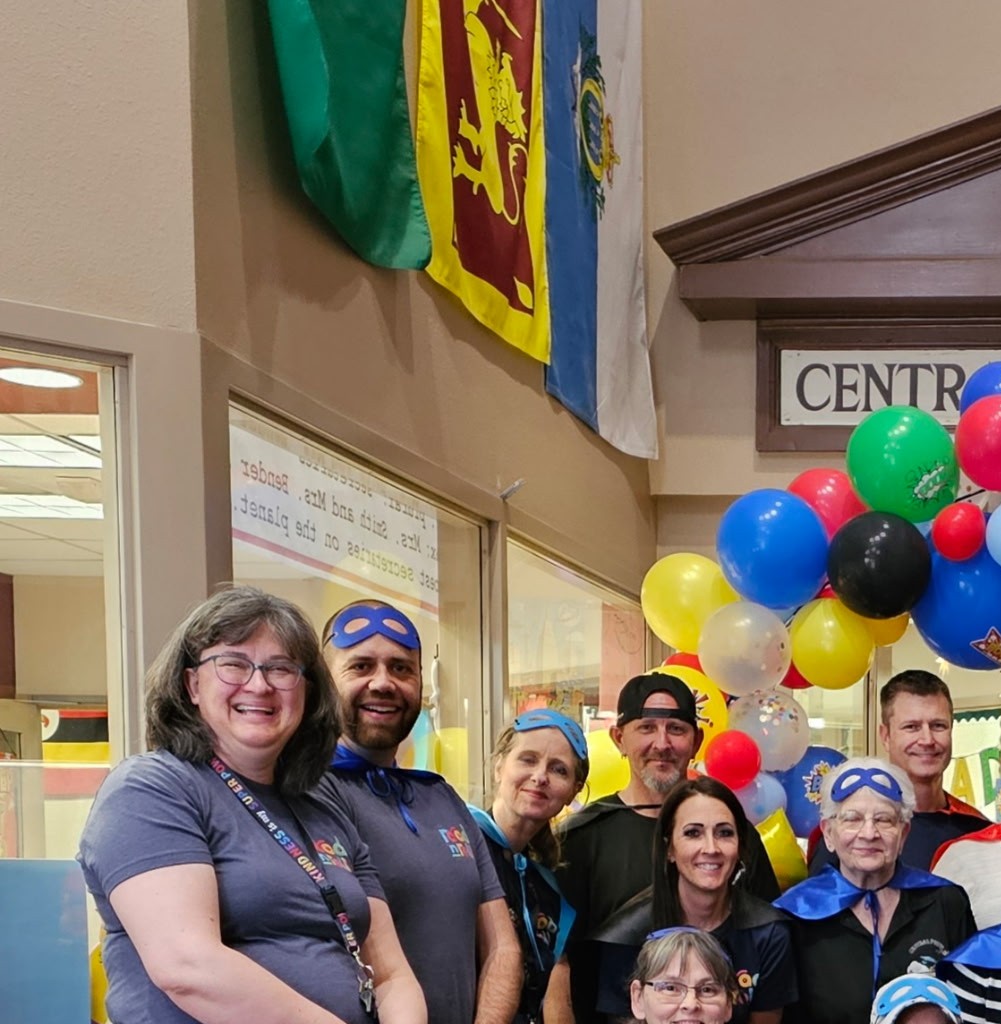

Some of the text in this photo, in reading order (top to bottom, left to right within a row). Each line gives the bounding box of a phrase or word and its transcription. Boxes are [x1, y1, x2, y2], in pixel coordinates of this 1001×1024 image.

[796, 362, 966, 412] CENTR
[210, 757, 232, 780] POW
[227, 778, 260, 811] SUPER
[273, 830, 326, 884] KINDNESS
